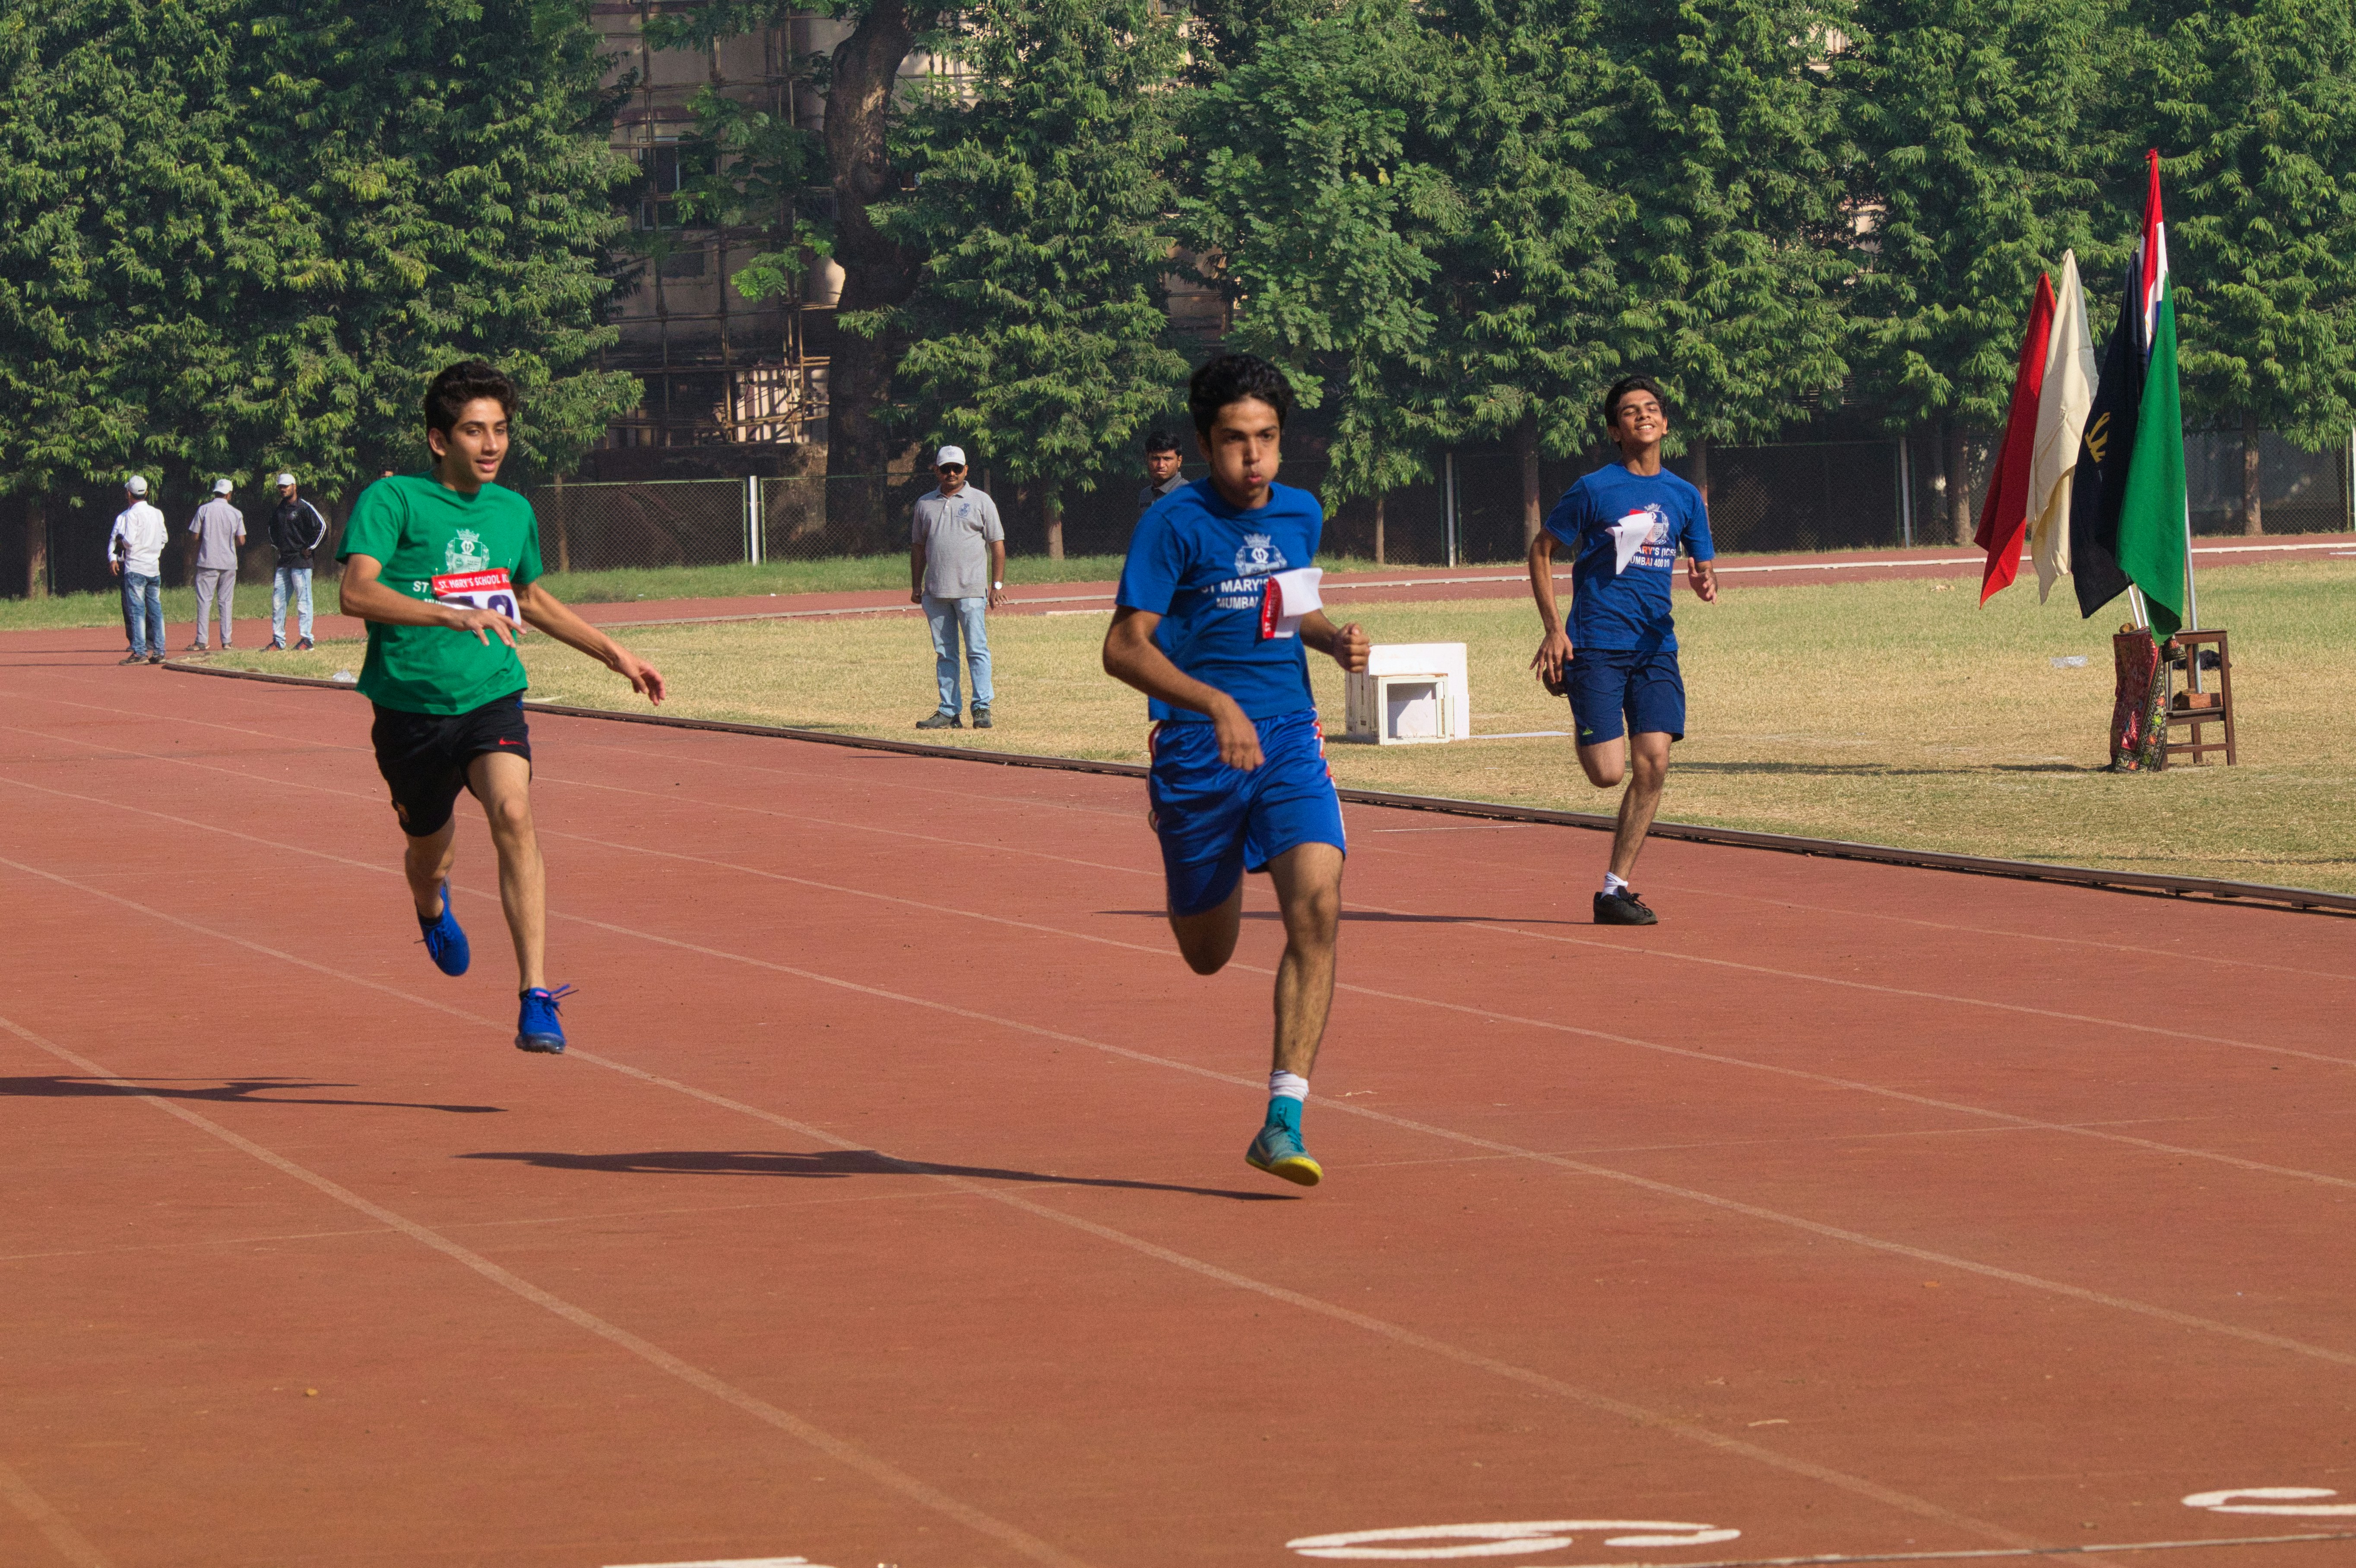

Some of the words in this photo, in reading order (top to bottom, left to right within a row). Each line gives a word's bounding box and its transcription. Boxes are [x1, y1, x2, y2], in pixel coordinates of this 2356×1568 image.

[1637, 546, 1660, 556] ARY'S
[1630, 556, 1653, 566] UMBAI
[1653, 559, 1663, 567] 400
[449, 578, 474, 588] MARY'S
[474, 574, 500, 586] SCHOOL
[413, 581, 429, 593] ST
